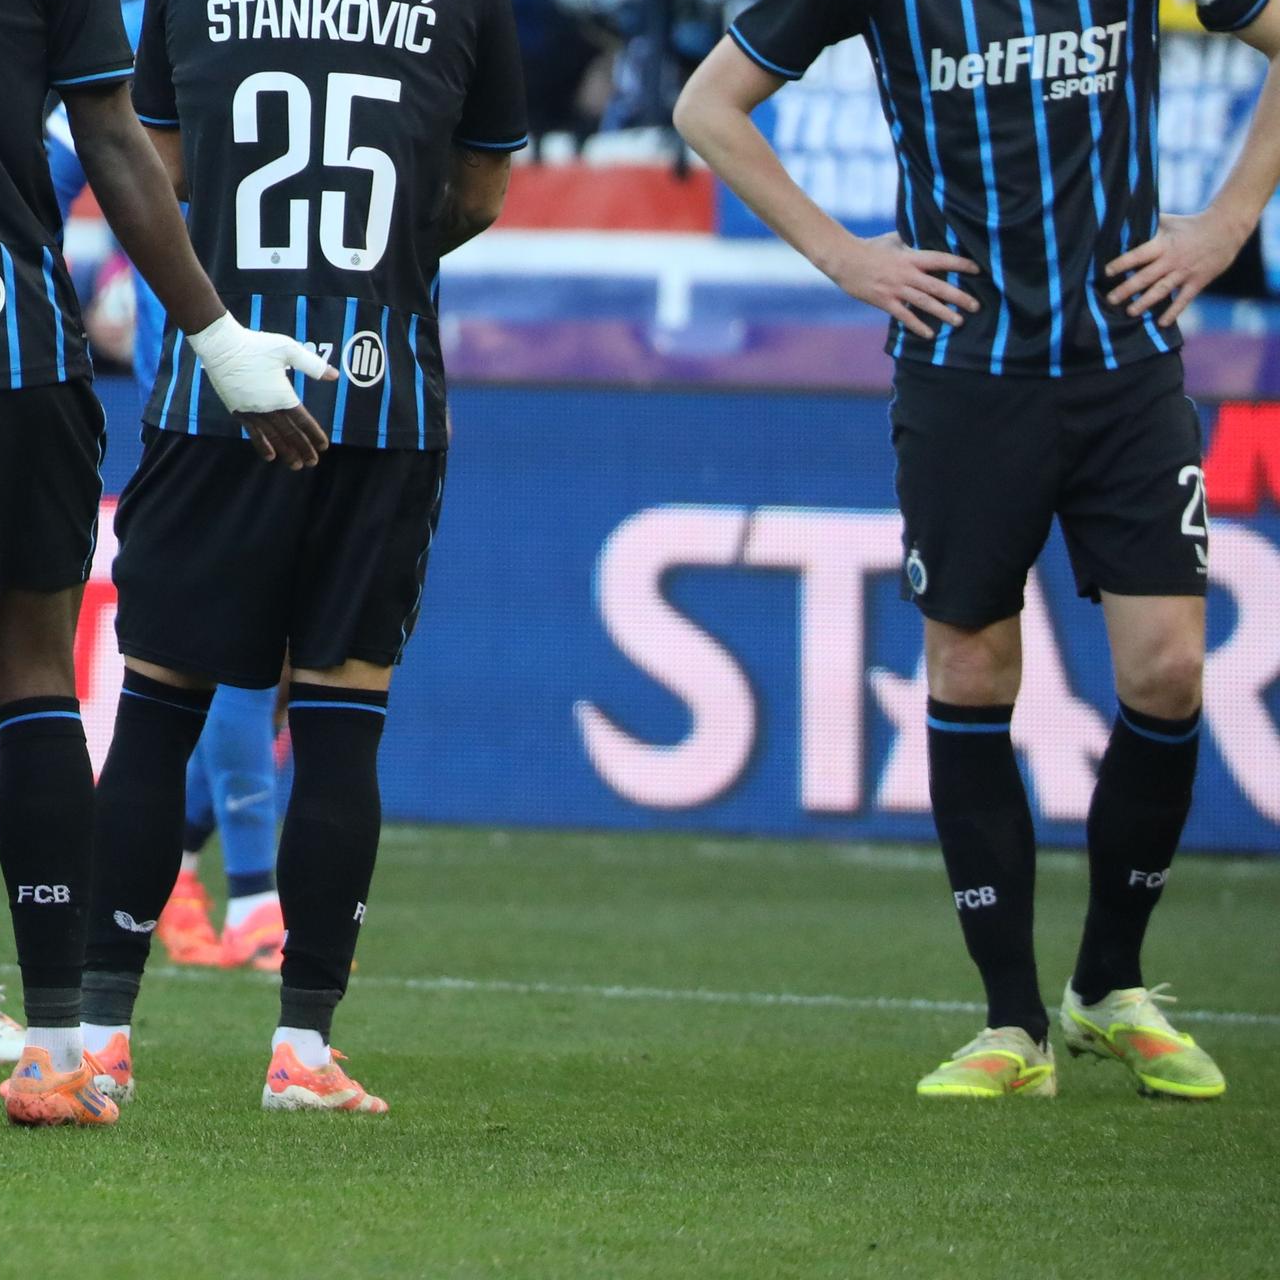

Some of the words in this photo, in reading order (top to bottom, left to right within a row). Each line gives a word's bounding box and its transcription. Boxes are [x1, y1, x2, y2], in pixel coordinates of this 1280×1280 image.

[930, 21, 1127, 92] betFIRST
[232, 71, 401, 271] 25
[1178, 465, 1207, 536] 2
[17, 885, 70, 904] FCB
[954, 886, 997, 910] FCB
